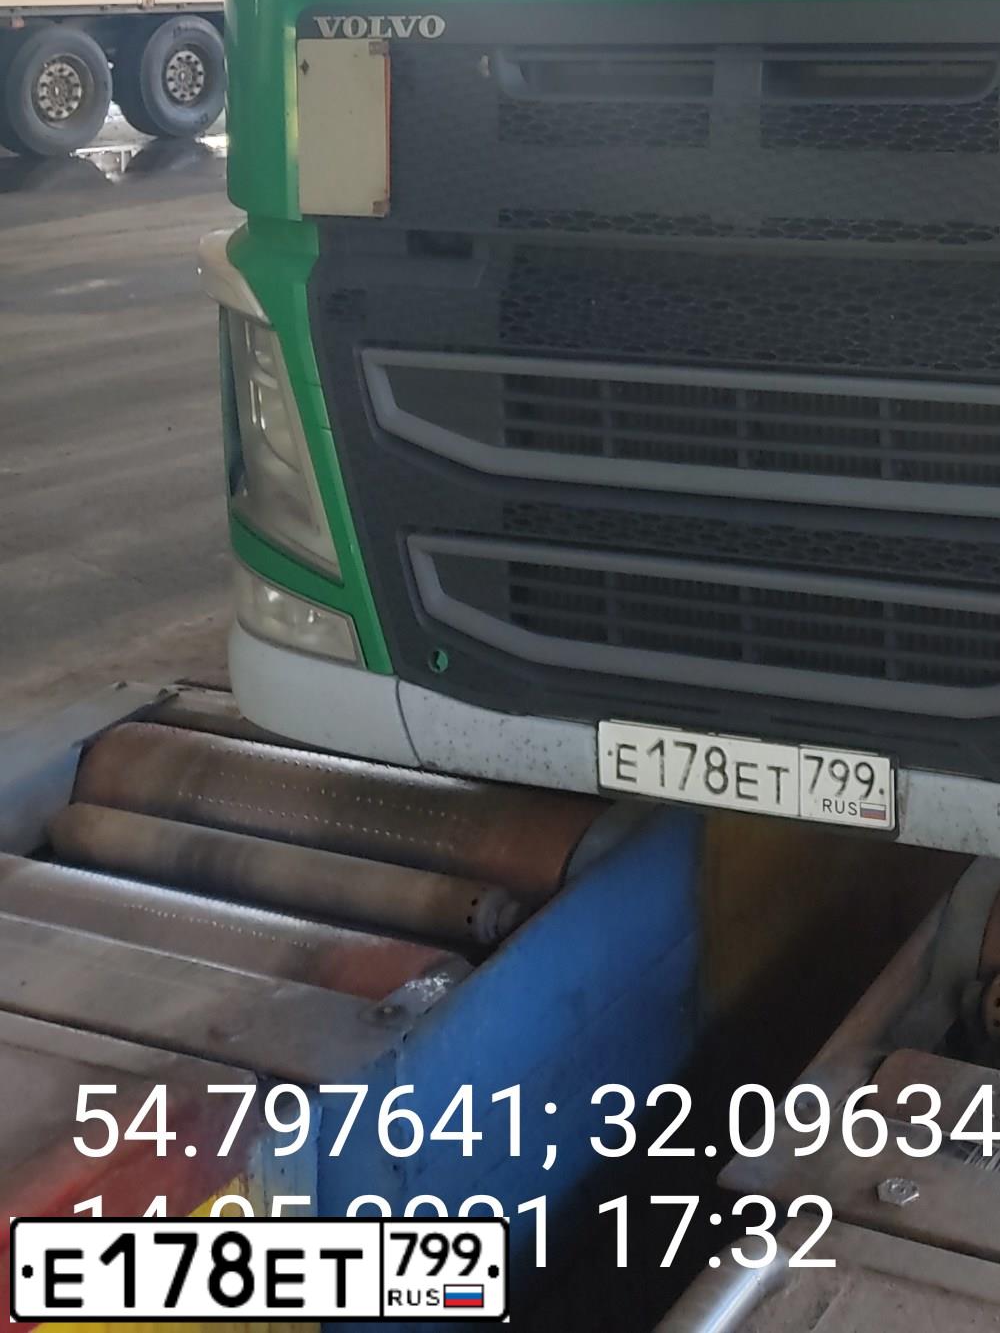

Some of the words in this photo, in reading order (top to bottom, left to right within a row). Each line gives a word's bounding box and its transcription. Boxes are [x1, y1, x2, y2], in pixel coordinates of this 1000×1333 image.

[314, 14, 446, 38] VOLVO
[803, 753, 876, 800] 799
[822, 797, 858, 817] RUS
